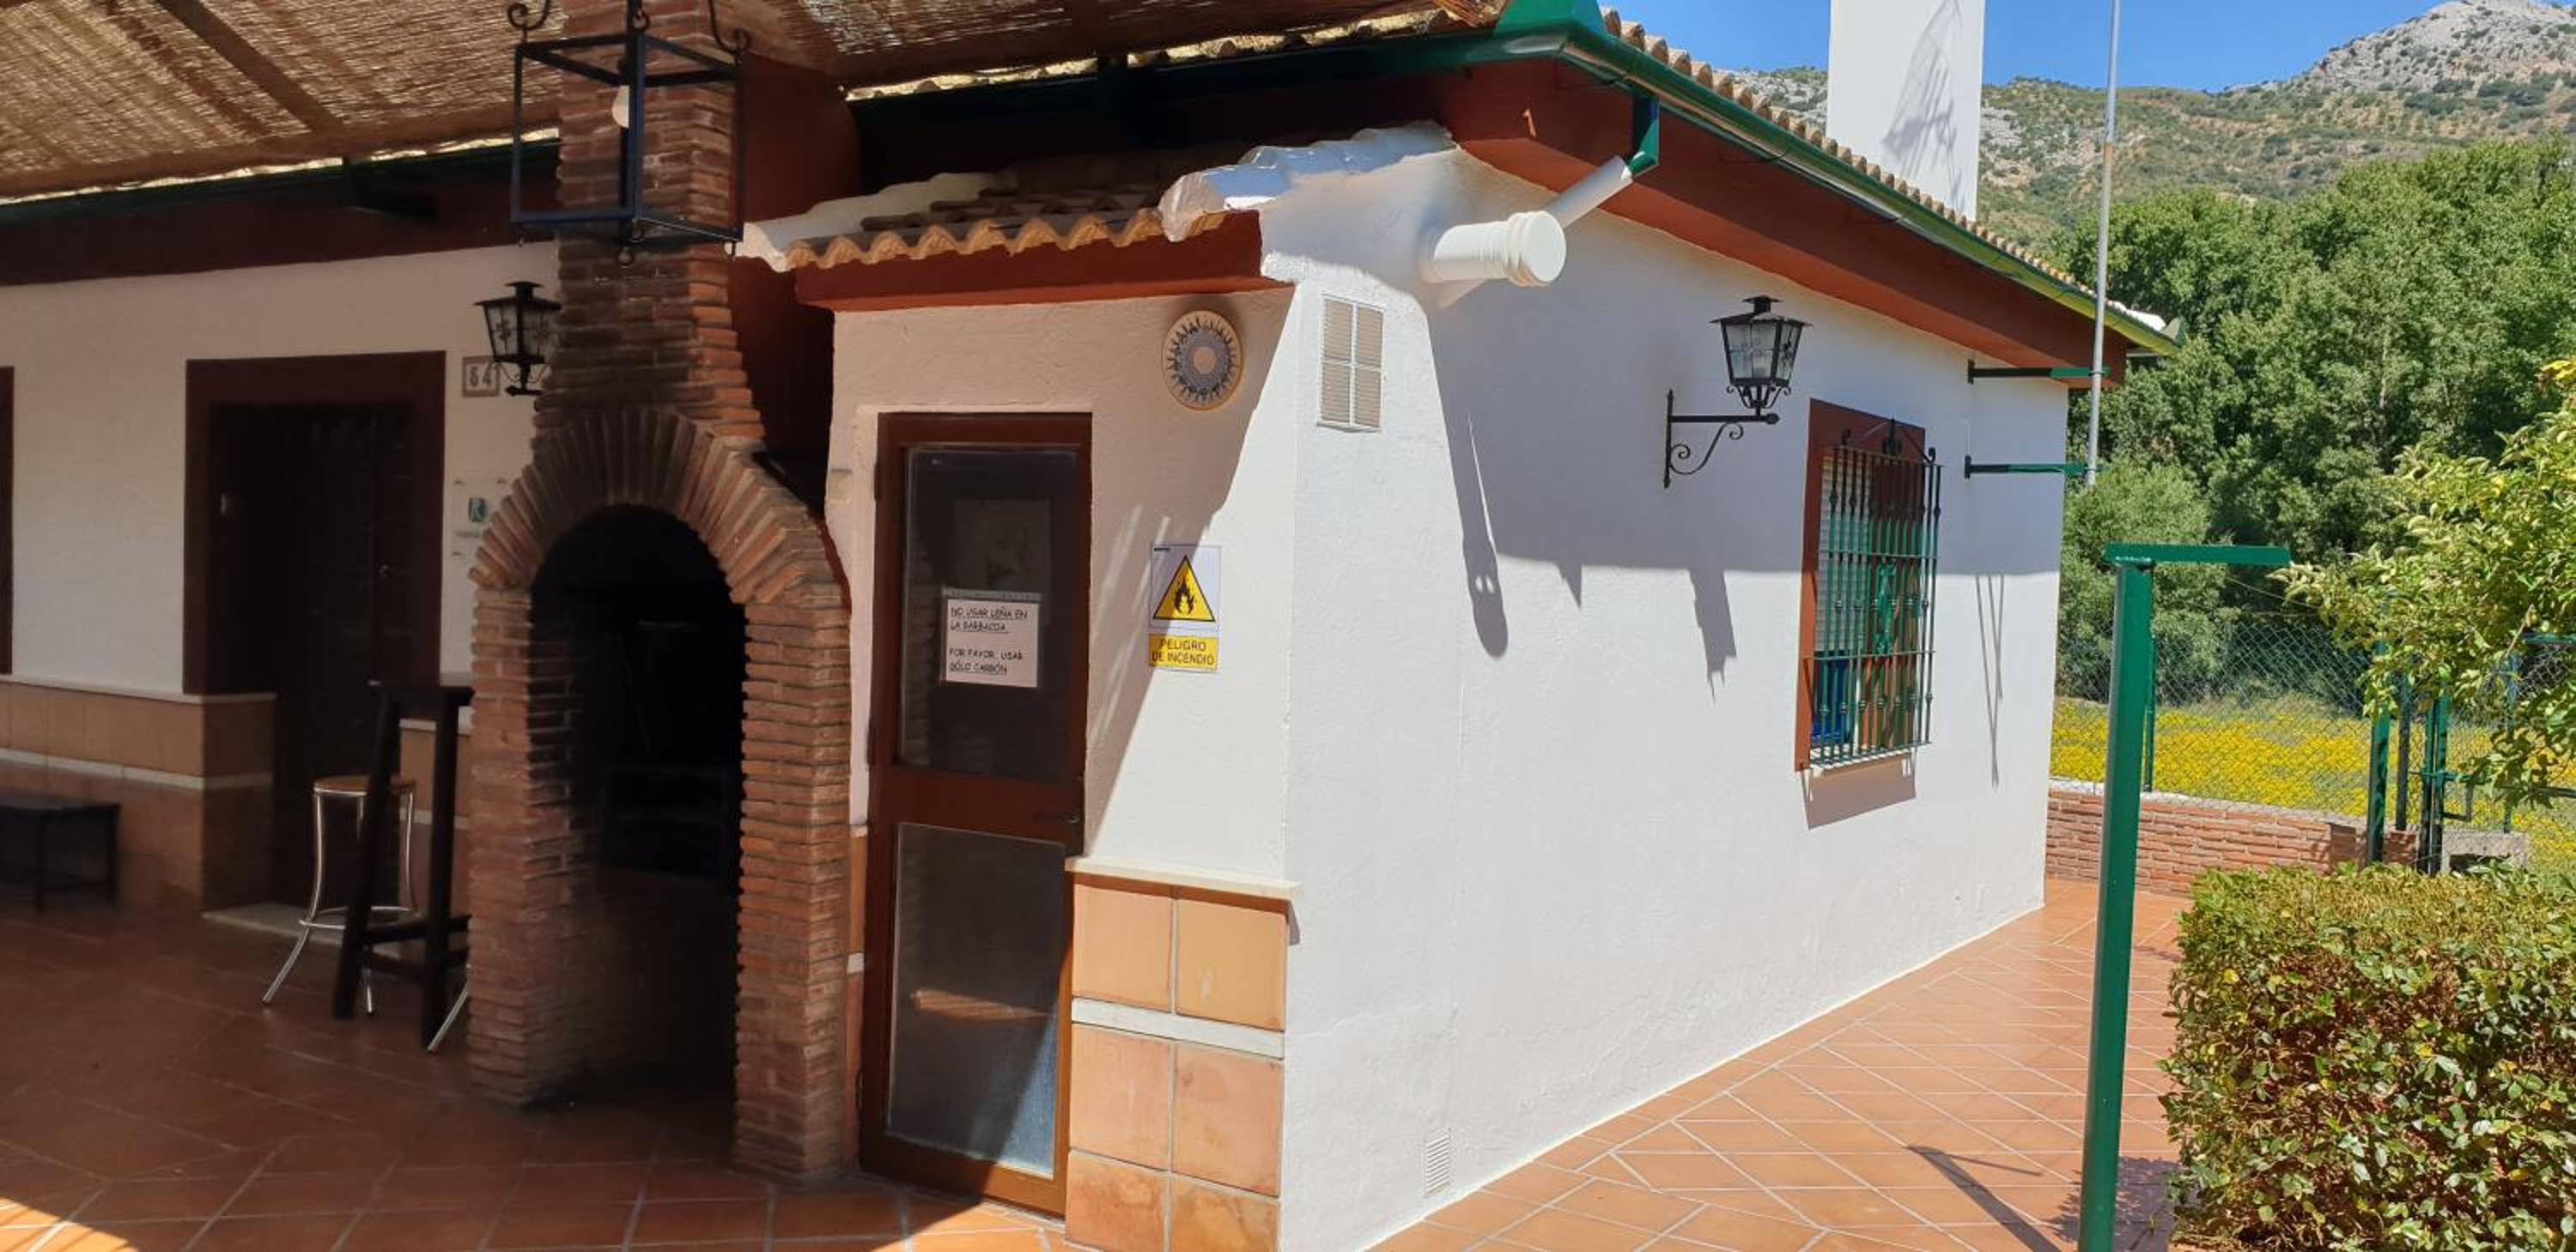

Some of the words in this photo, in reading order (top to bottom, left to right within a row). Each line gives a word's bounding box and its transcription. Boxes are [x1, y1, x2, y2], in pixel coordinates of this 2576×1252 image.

[951, 607, 963, 617] NO
[966, 607, 988, 617] USAR
[1014, 609, 1028, 619] EN
[951, 620, 961, 630] LA
[1160, 638, 1206, 651] PELIGRO
[949, 647, 965, 657] POR
[1000, 651, 1024, 660] USAR
[1151, 650, 1163, 661] DE
[1167, 651, 1215, 665] INCENDIO
